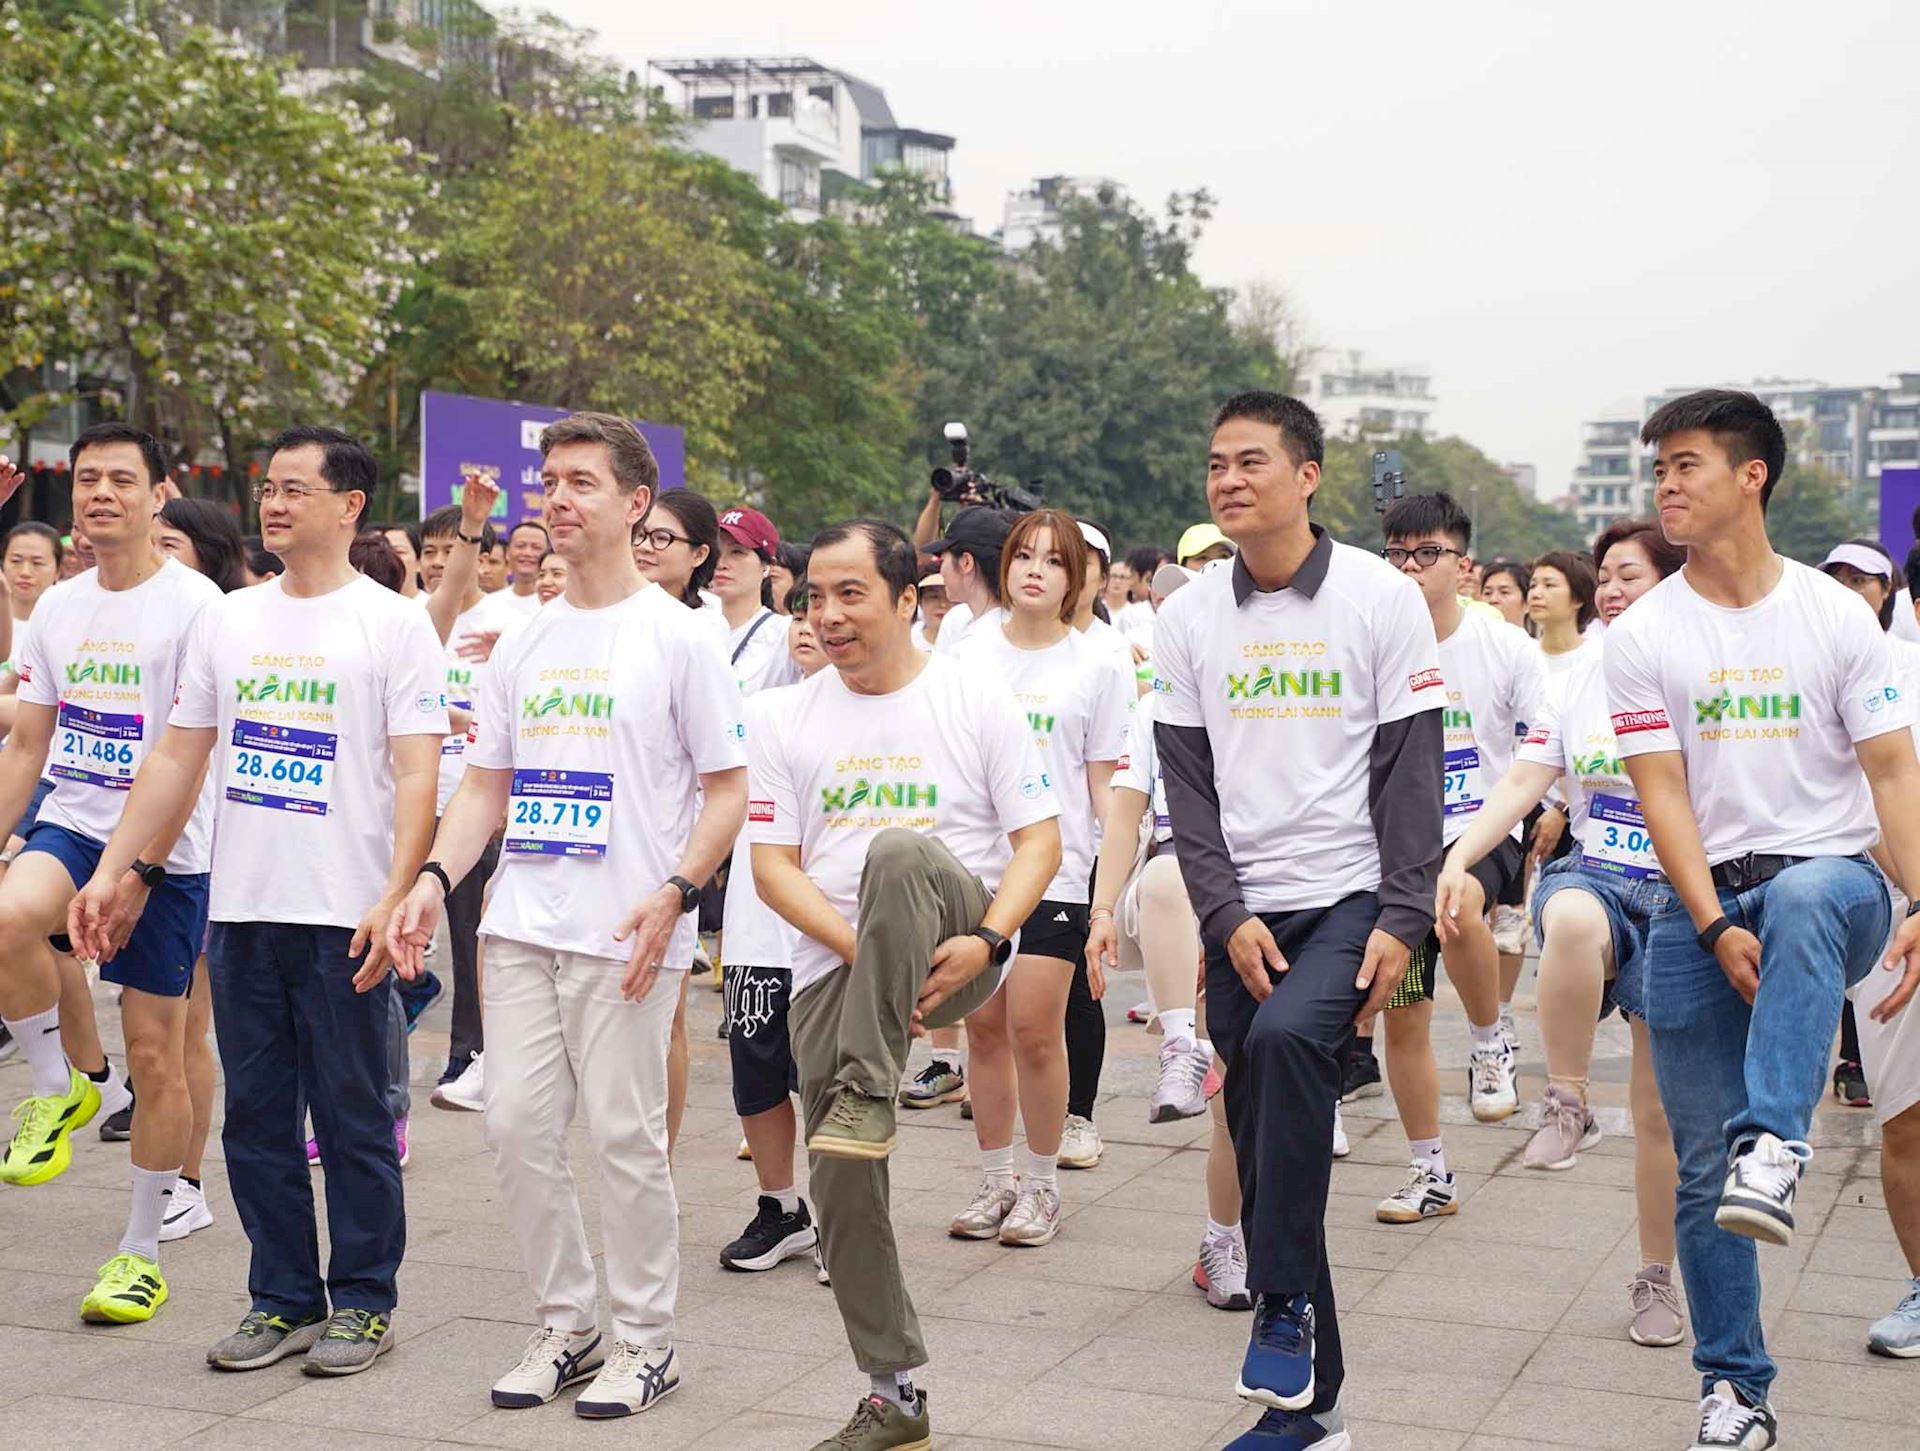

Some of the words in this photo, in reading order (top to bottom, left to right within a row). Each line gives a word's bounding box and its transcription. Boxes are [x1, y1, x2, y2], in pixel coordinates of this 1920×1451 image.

[63, 732, 133, 764] 21.486
[321, 749, 334, 757] km
[236, 752, 323, 786] 28.604
[515, 801, 602, 828] 28.719
